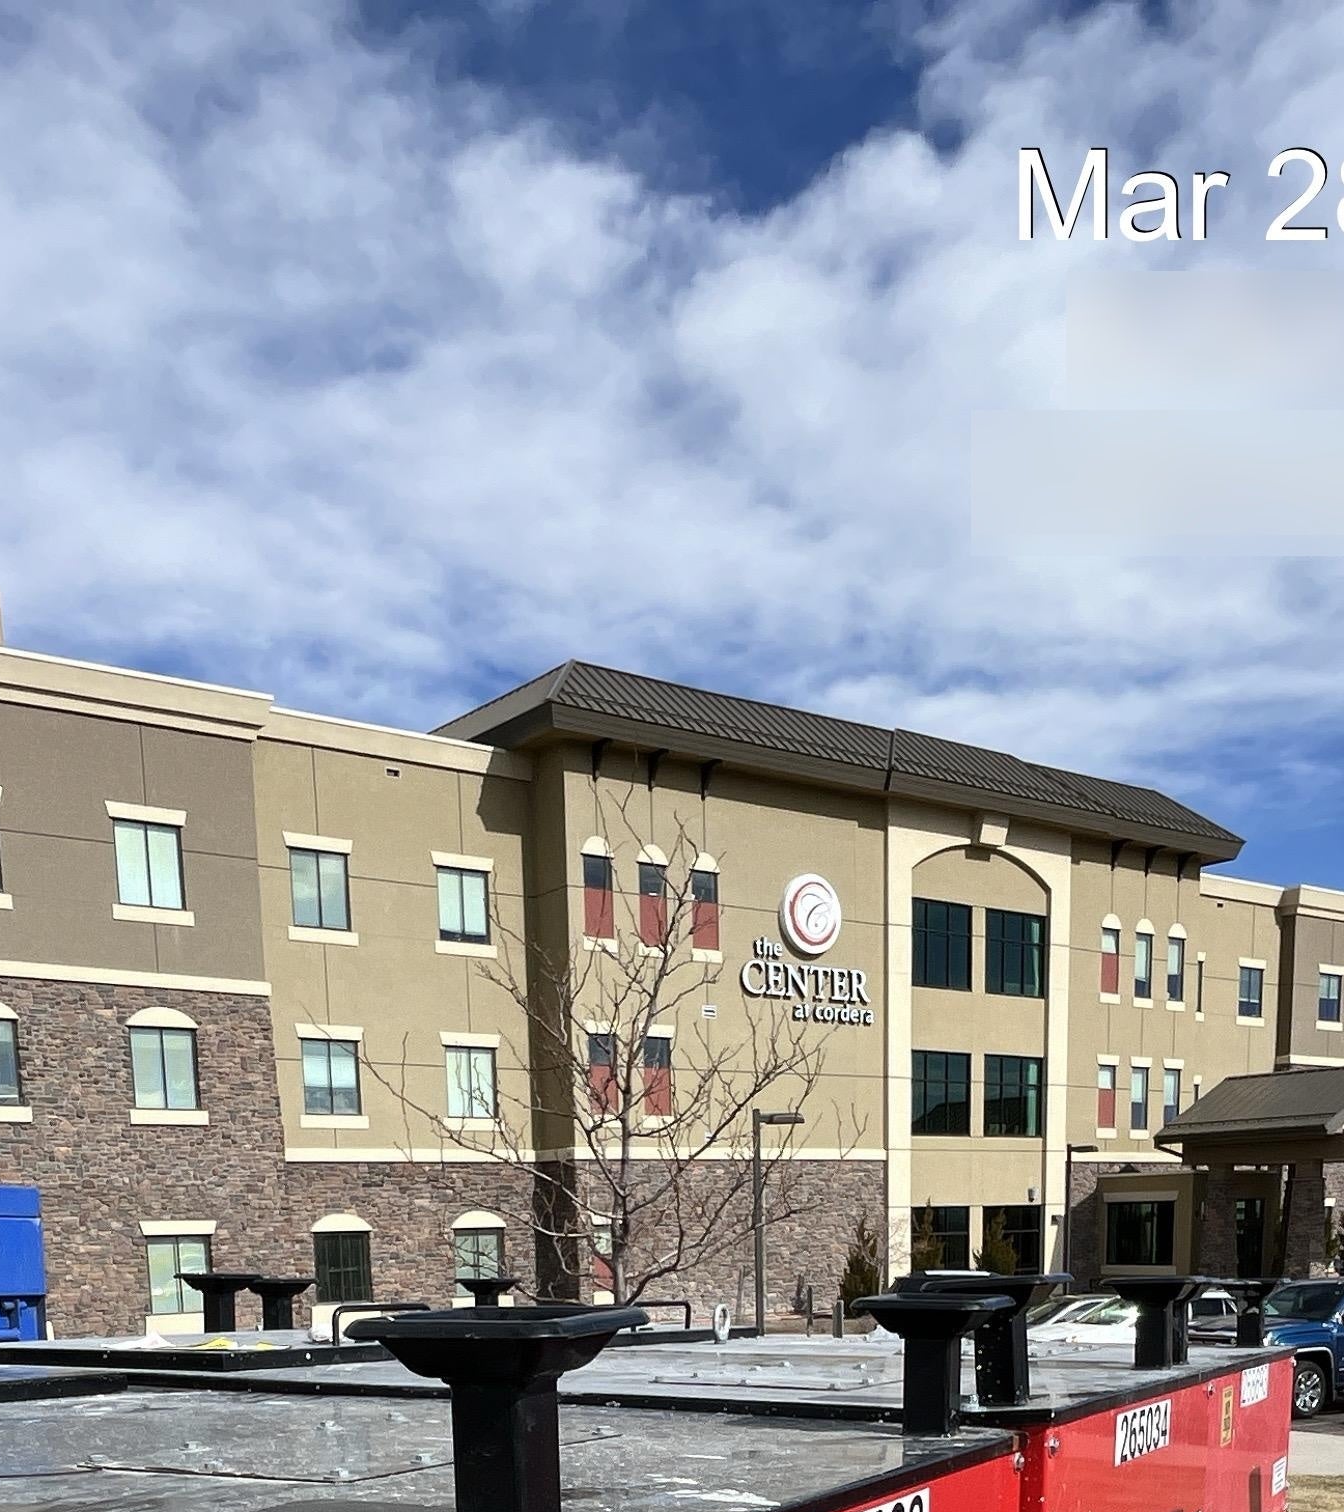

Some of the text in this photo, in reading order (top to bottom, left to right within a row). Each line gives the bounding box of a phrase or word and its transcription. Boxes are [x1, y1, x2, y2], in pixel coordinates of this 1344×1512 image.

[753, 937, 783, 959] the
[740, 960, 871, 1003] CENTER
[793, 1003, 875, 1026] at cordera
[1120, 1403, 1169, 1463] 265034
